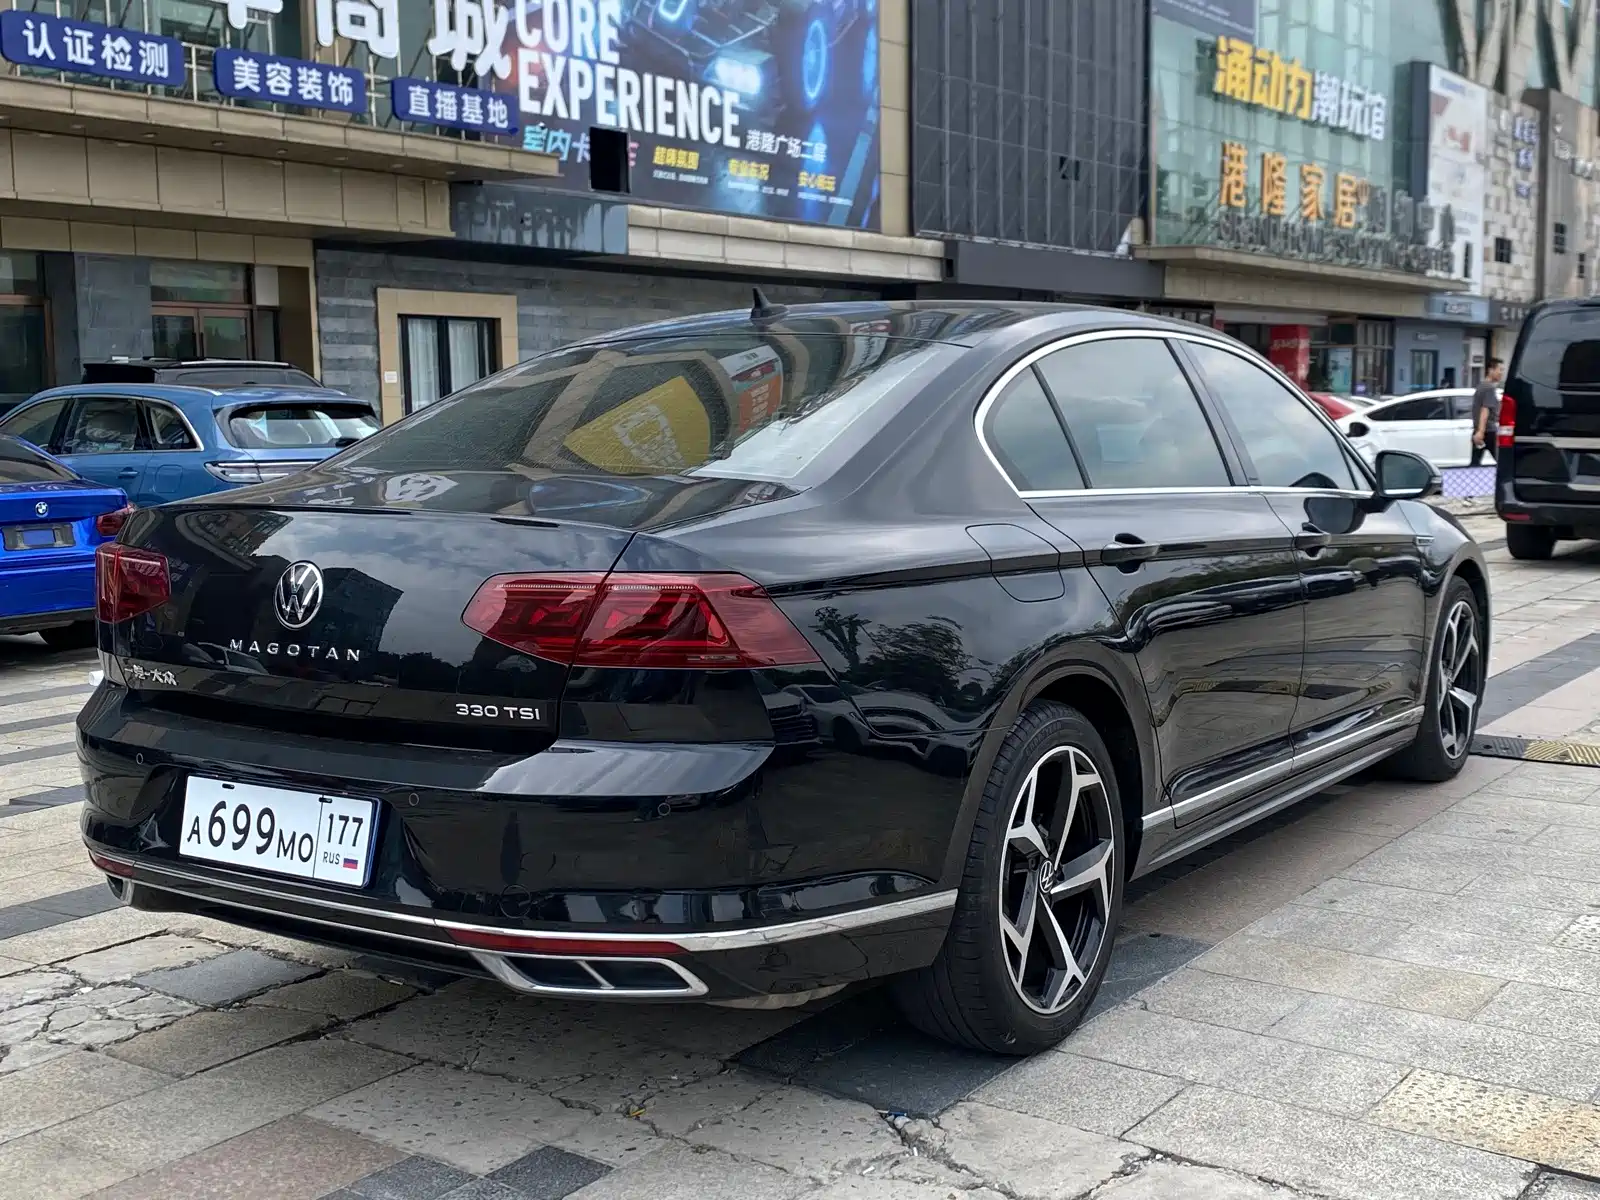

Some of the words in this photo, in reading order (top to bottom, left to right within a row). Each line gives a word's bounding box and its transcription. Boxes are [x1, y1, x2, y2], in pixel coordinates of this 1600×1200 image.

[22, 21, 170, 79] 认证检测
[514, 0, 621, 65] CORE
[232, 56, 354, 107] 美容装饰
[517, 47, 742, 149] EXPERIENCE
[408, 85, 509, 128] 直播基地
[1220, 140, 1357, 228] 港隆家居
[229, 638, 361, 662] MAGOTAN
[455, 702, 500, 719] 330
[503, 705, 541, 721] TSI
[327, 813, 364, 847] 177
[322, 851, 341, 865] RUS
